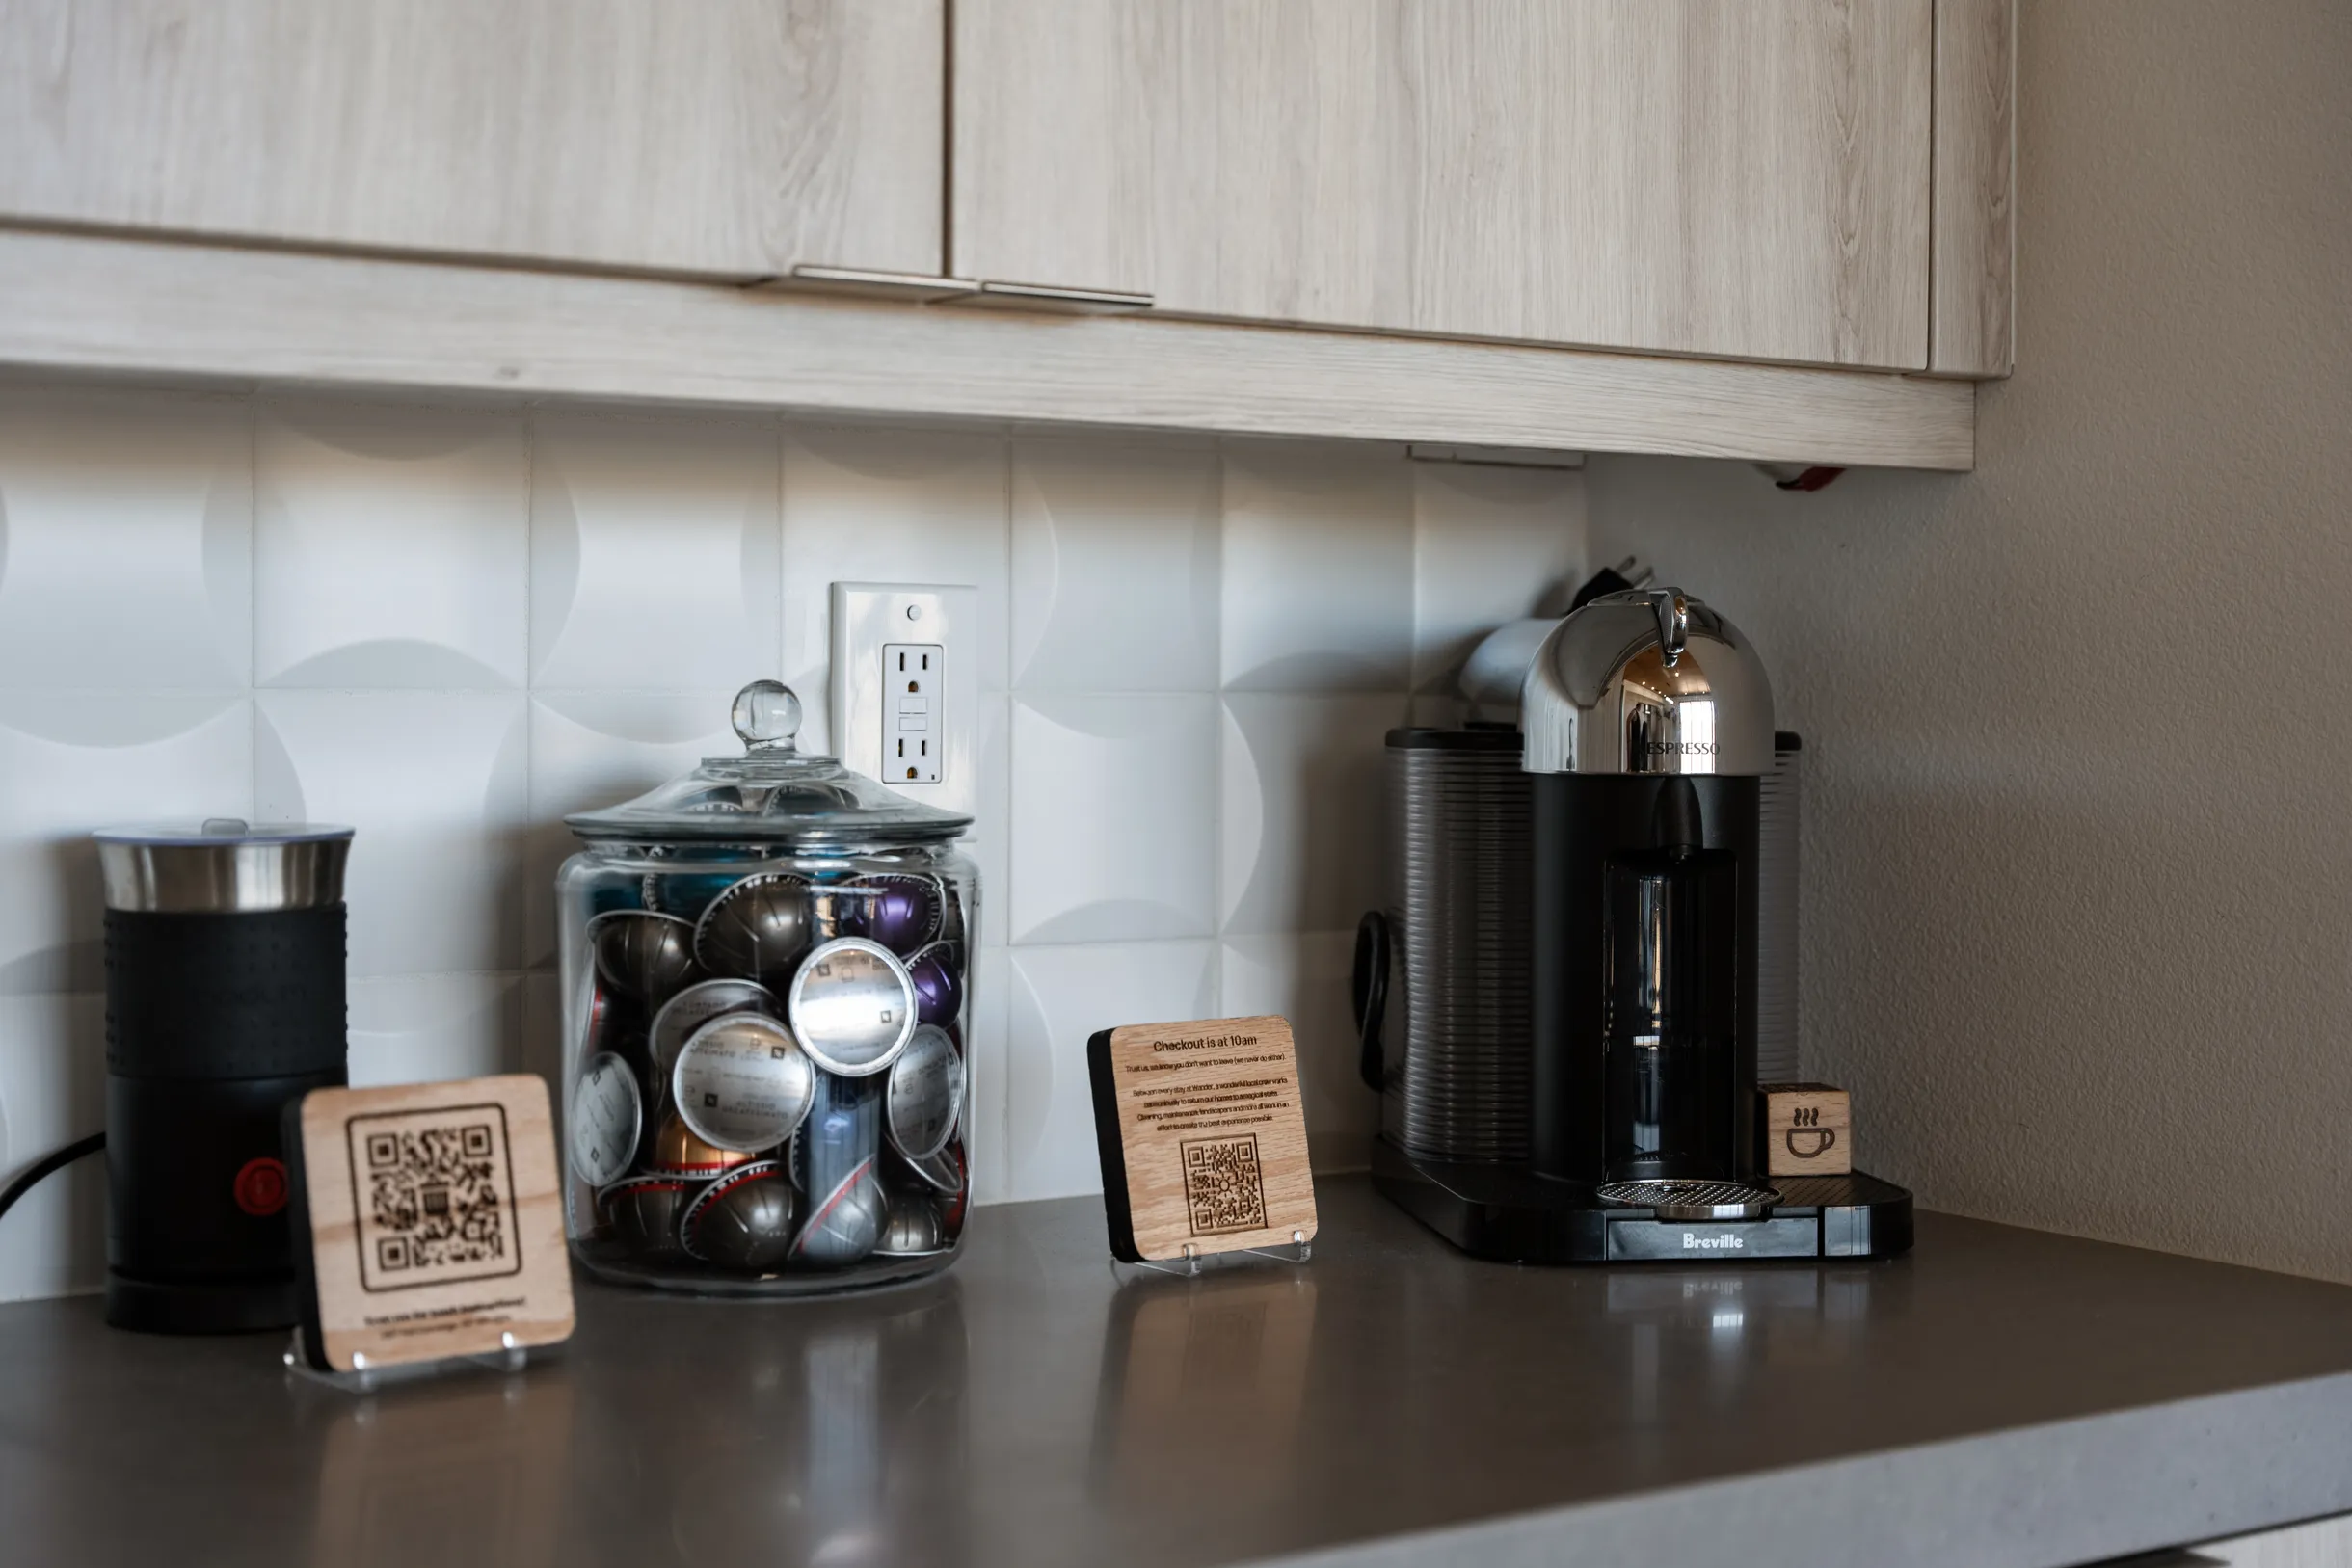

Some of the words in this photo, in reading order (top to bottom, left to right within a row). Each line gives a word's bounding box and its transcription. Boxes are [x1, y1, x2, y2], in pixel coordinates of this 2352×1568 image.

[1639, 742, 1720, 755] ESPRESSO
[1153, 1038, 1205, 1051] Checkout
[1206, 1036, 1216, 1048] is
[1217, 1036, 1228, 1047] at
[1230, 1035, 1257, 1046] 10am
[1234, 1056, 1244, 1064] (we
[1158, 1087, 1173, 1095] every
[1208, 1119, 1221, 1127] best
[1683, 1233, 1743, 1249] Breville
